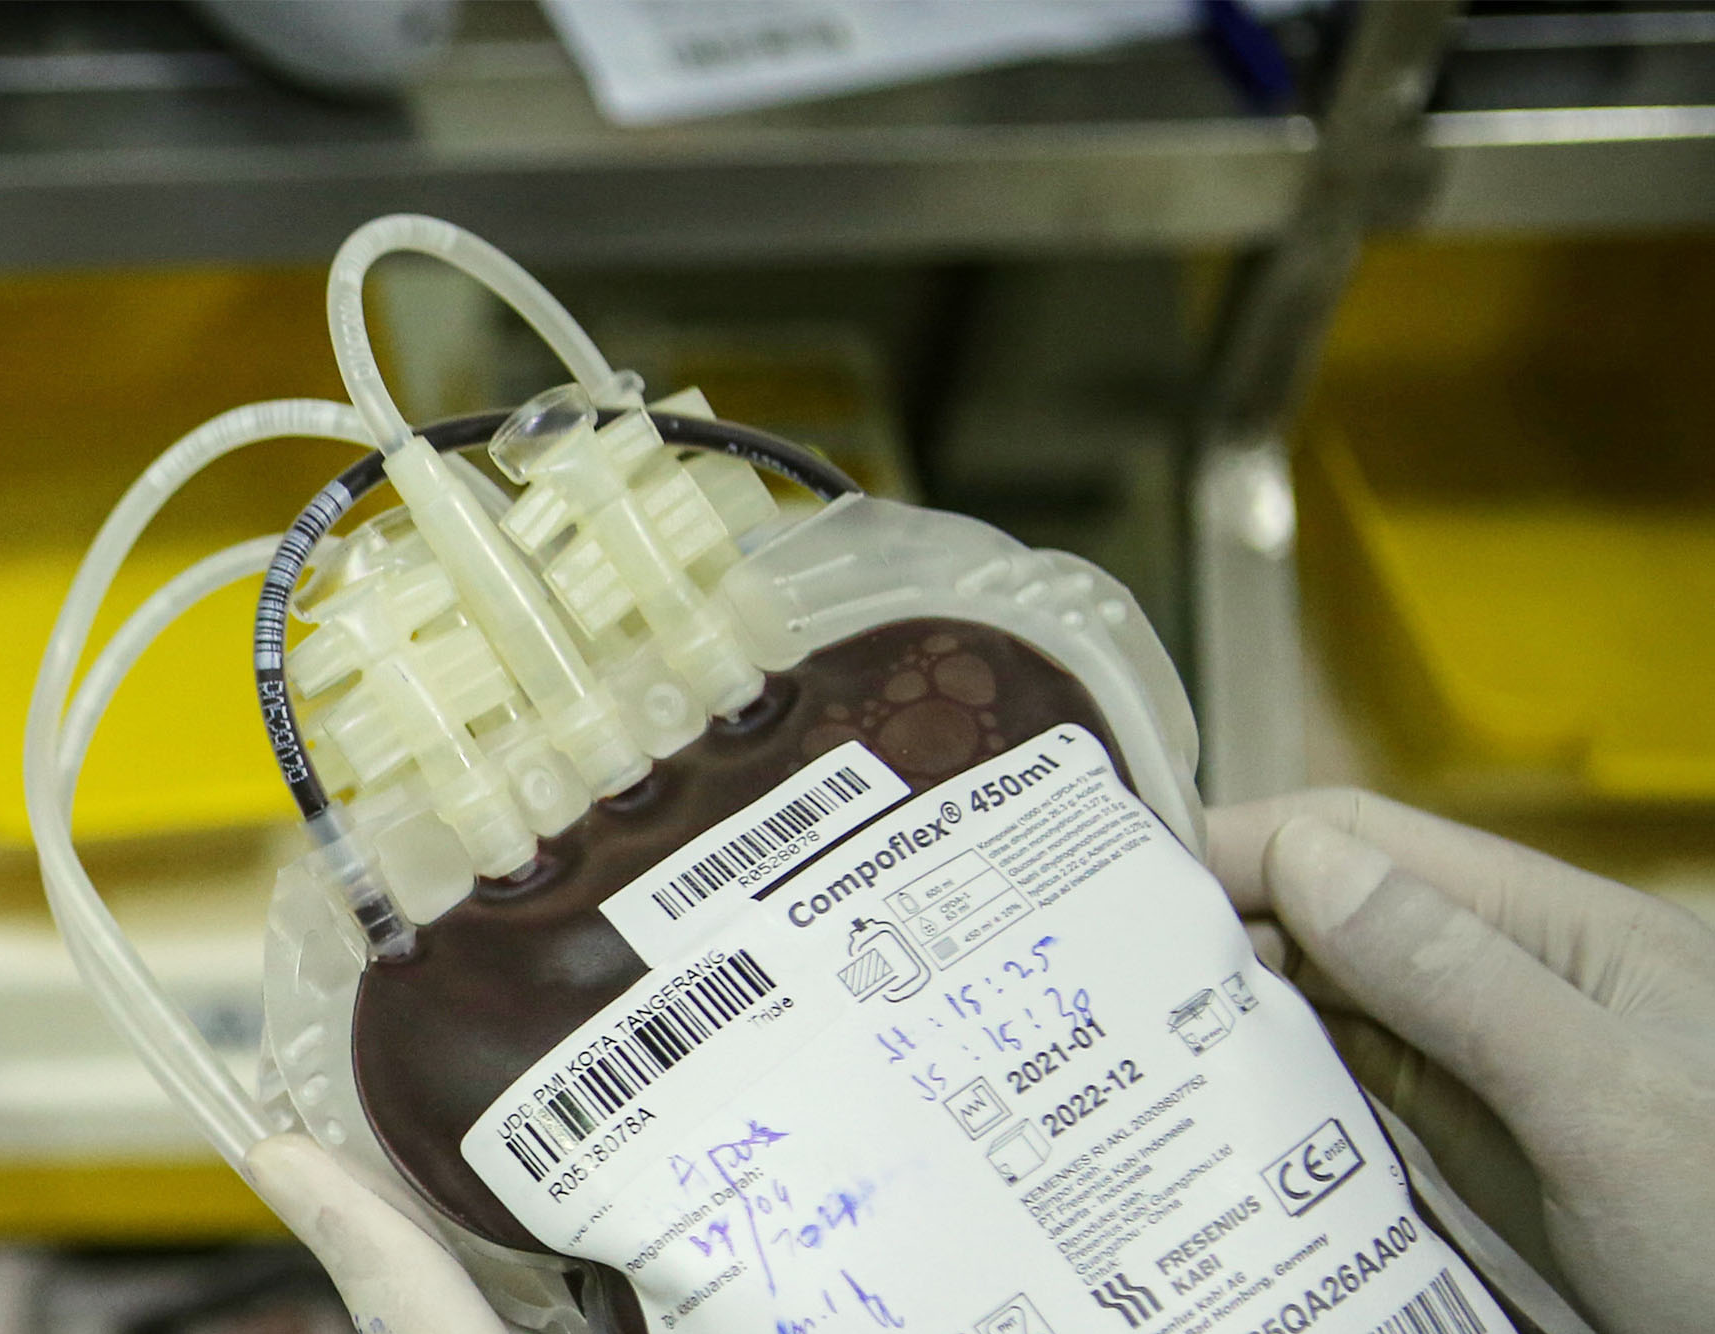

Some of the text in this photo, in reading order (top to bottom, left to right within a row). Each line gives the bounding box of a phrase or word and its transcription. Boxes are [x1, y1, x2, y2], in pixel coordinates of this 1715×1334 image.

[965, 748, 1062, 817] 450ml
[737, 829, 821, 890] R0528078
[496, 946, 726, 1141] UDD PMI KOTA TANGERANG
[1005, 1015, 1108, 1096] 2021-01
[1039, 1055, 1145, 1139] 2022-12
[1020, 1152, 1093, 1208] KEMENKES
[1104, 1125, 1132, 1149] AKL
[1037, 1114, 1195, 1229] PT Fresenius Kabi Indonesia
[1045, 1161, 1153, 1240] Jakarta Indonesia
[624, 1200, 713, 1276] Pengambilan
[1065, 1220, 1124, 1265] Fresenius
[1121, 1201, 1150, 1225] Kabi
[1074, 1196, 1183, 1277] Guangzhou China
[1155, 1193, 1263, 1277] FRESENIUS
[1272, 1233, 1331, 1279] Germany
[1170, 1252, 1223, 1297] KABI
[1195, 1285, 1228, 1312] Kabi
[1226, 1271, 1249, 1292] AG
